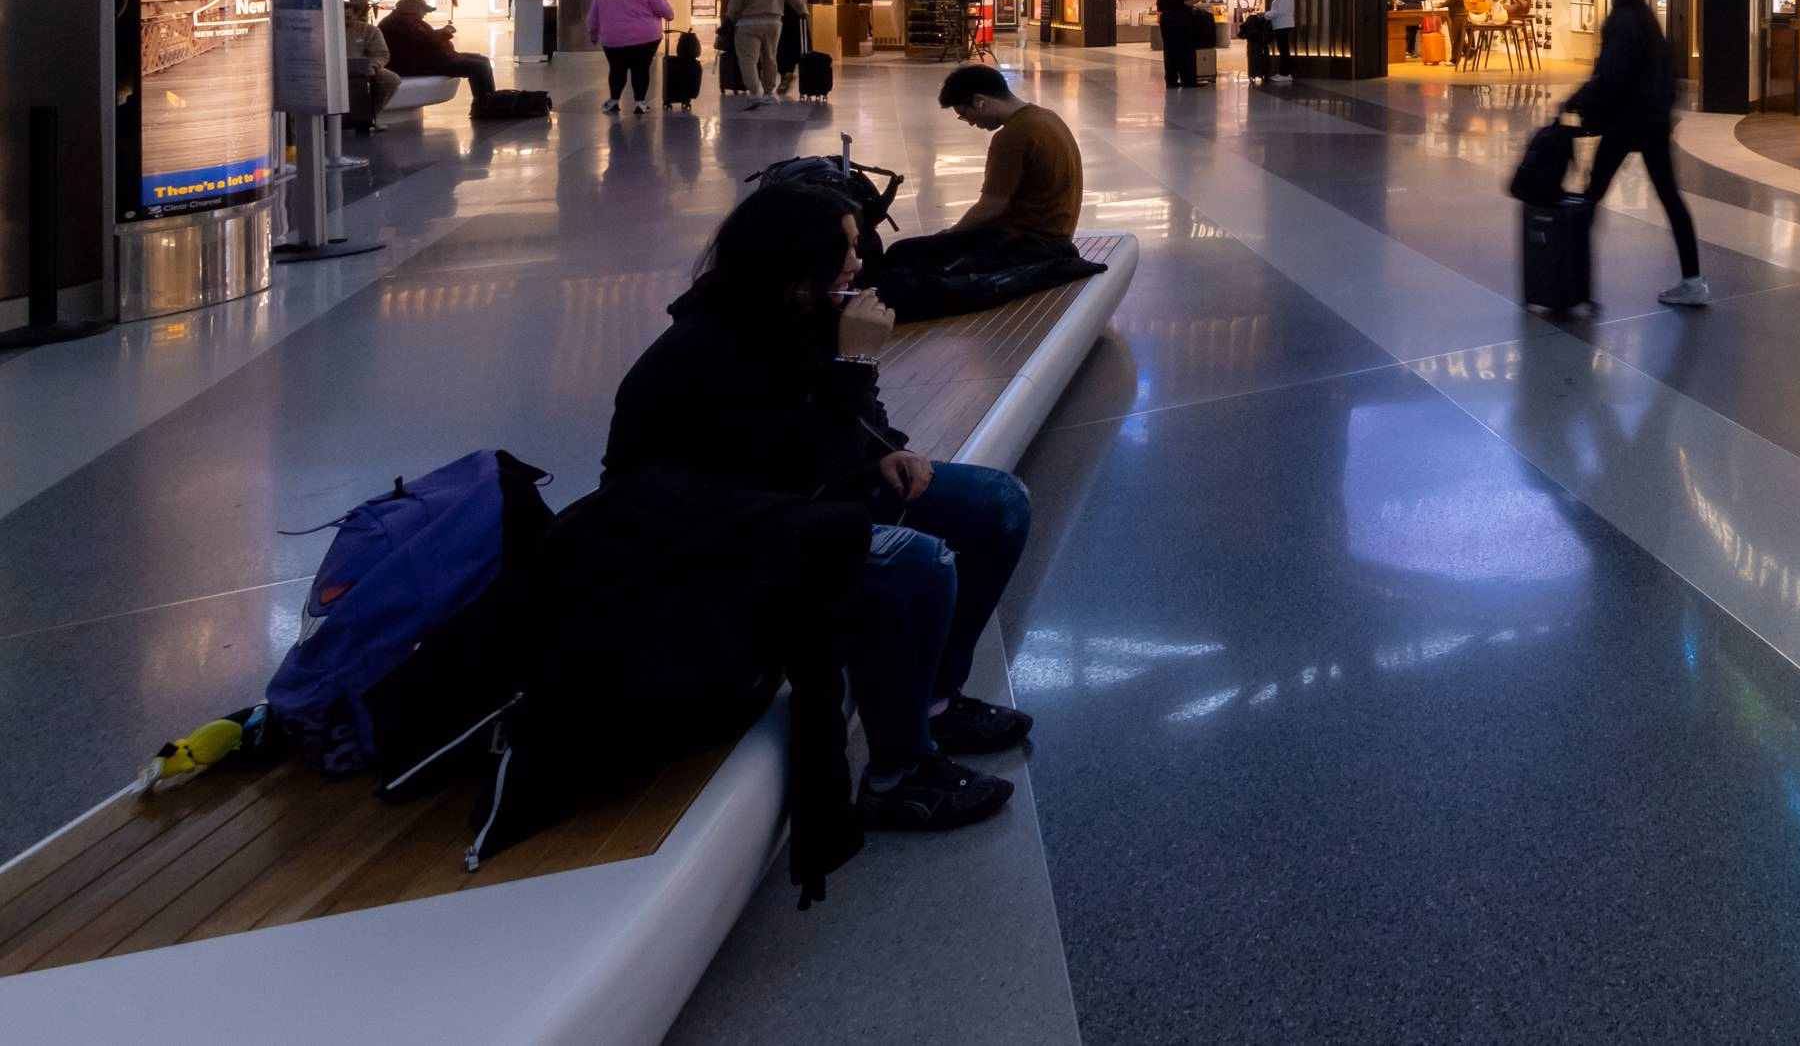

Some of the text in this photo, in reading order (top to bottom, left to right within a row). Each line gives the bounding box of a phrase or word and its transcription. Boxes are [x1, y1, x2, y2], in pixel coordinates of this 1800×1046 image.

[154, 174, 254, 198] There's a lot to
[163, 203, 187, 212] Clear
